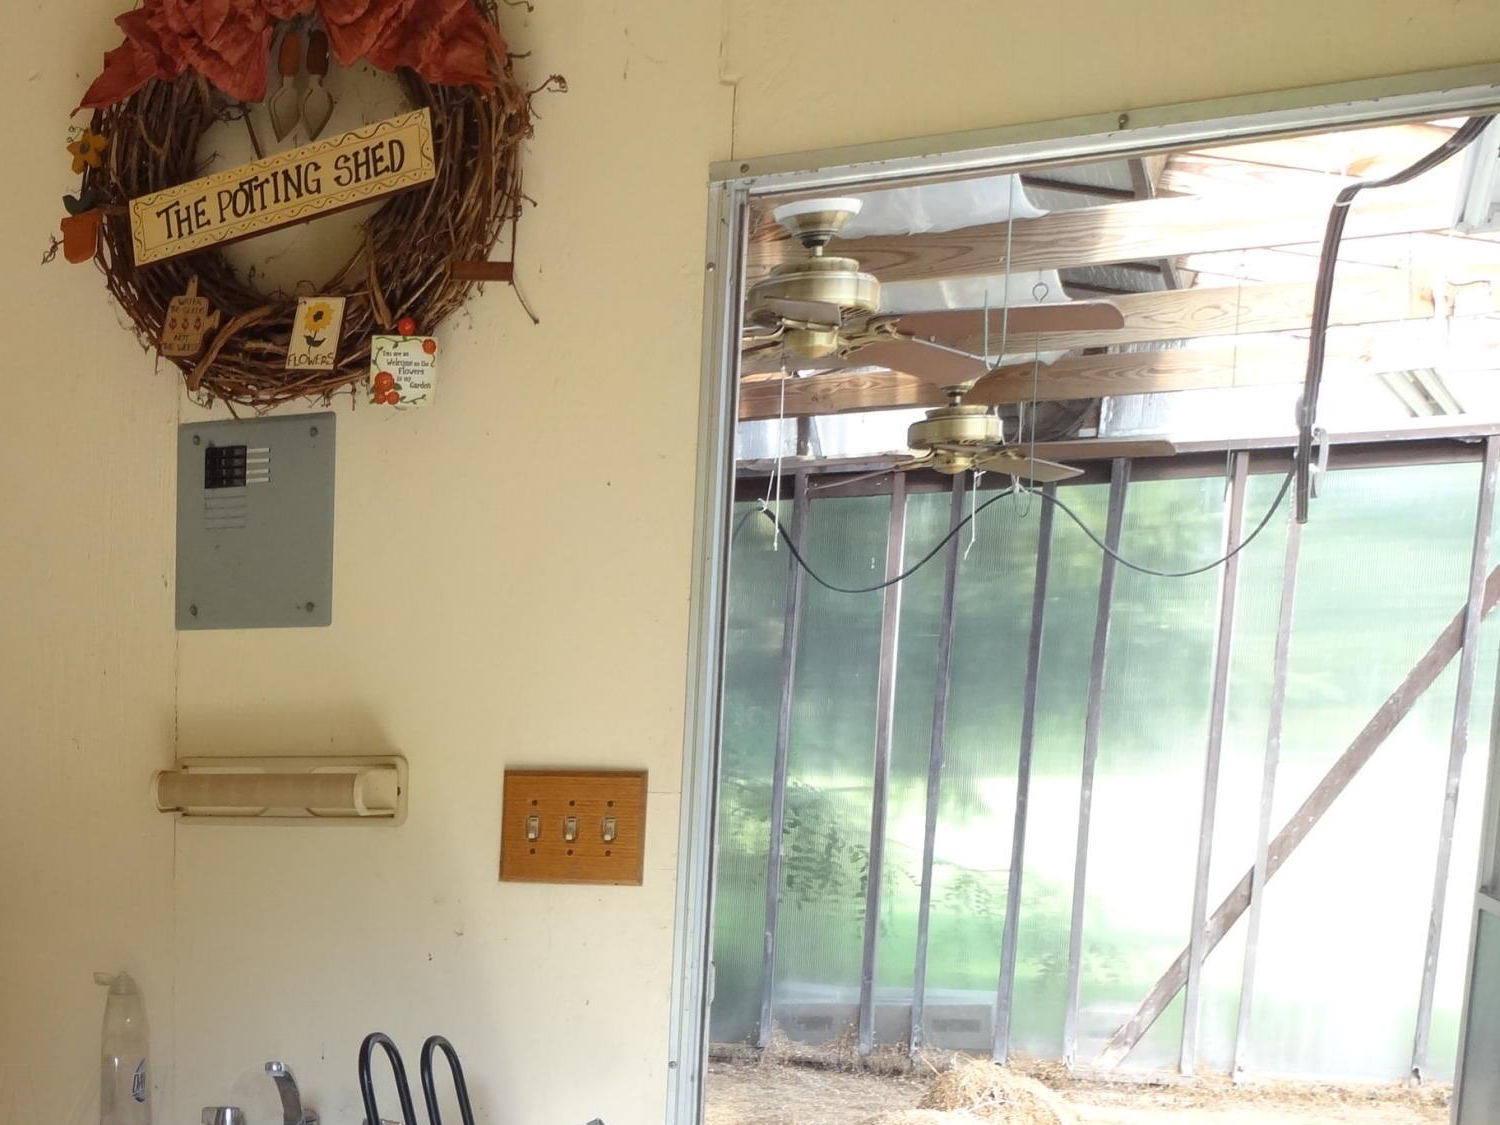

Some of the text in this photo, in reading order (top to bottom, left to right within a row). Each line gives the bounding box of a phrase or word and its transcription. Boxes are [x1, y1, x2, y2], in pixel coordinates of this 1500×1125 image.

[156, 139, 405, 240] THE POTTING SHED
[287, 351, 335, 367] FLOWERS
[386, 358, 413, 367] Welcome
[398, 366, 425, 375] Flowers
